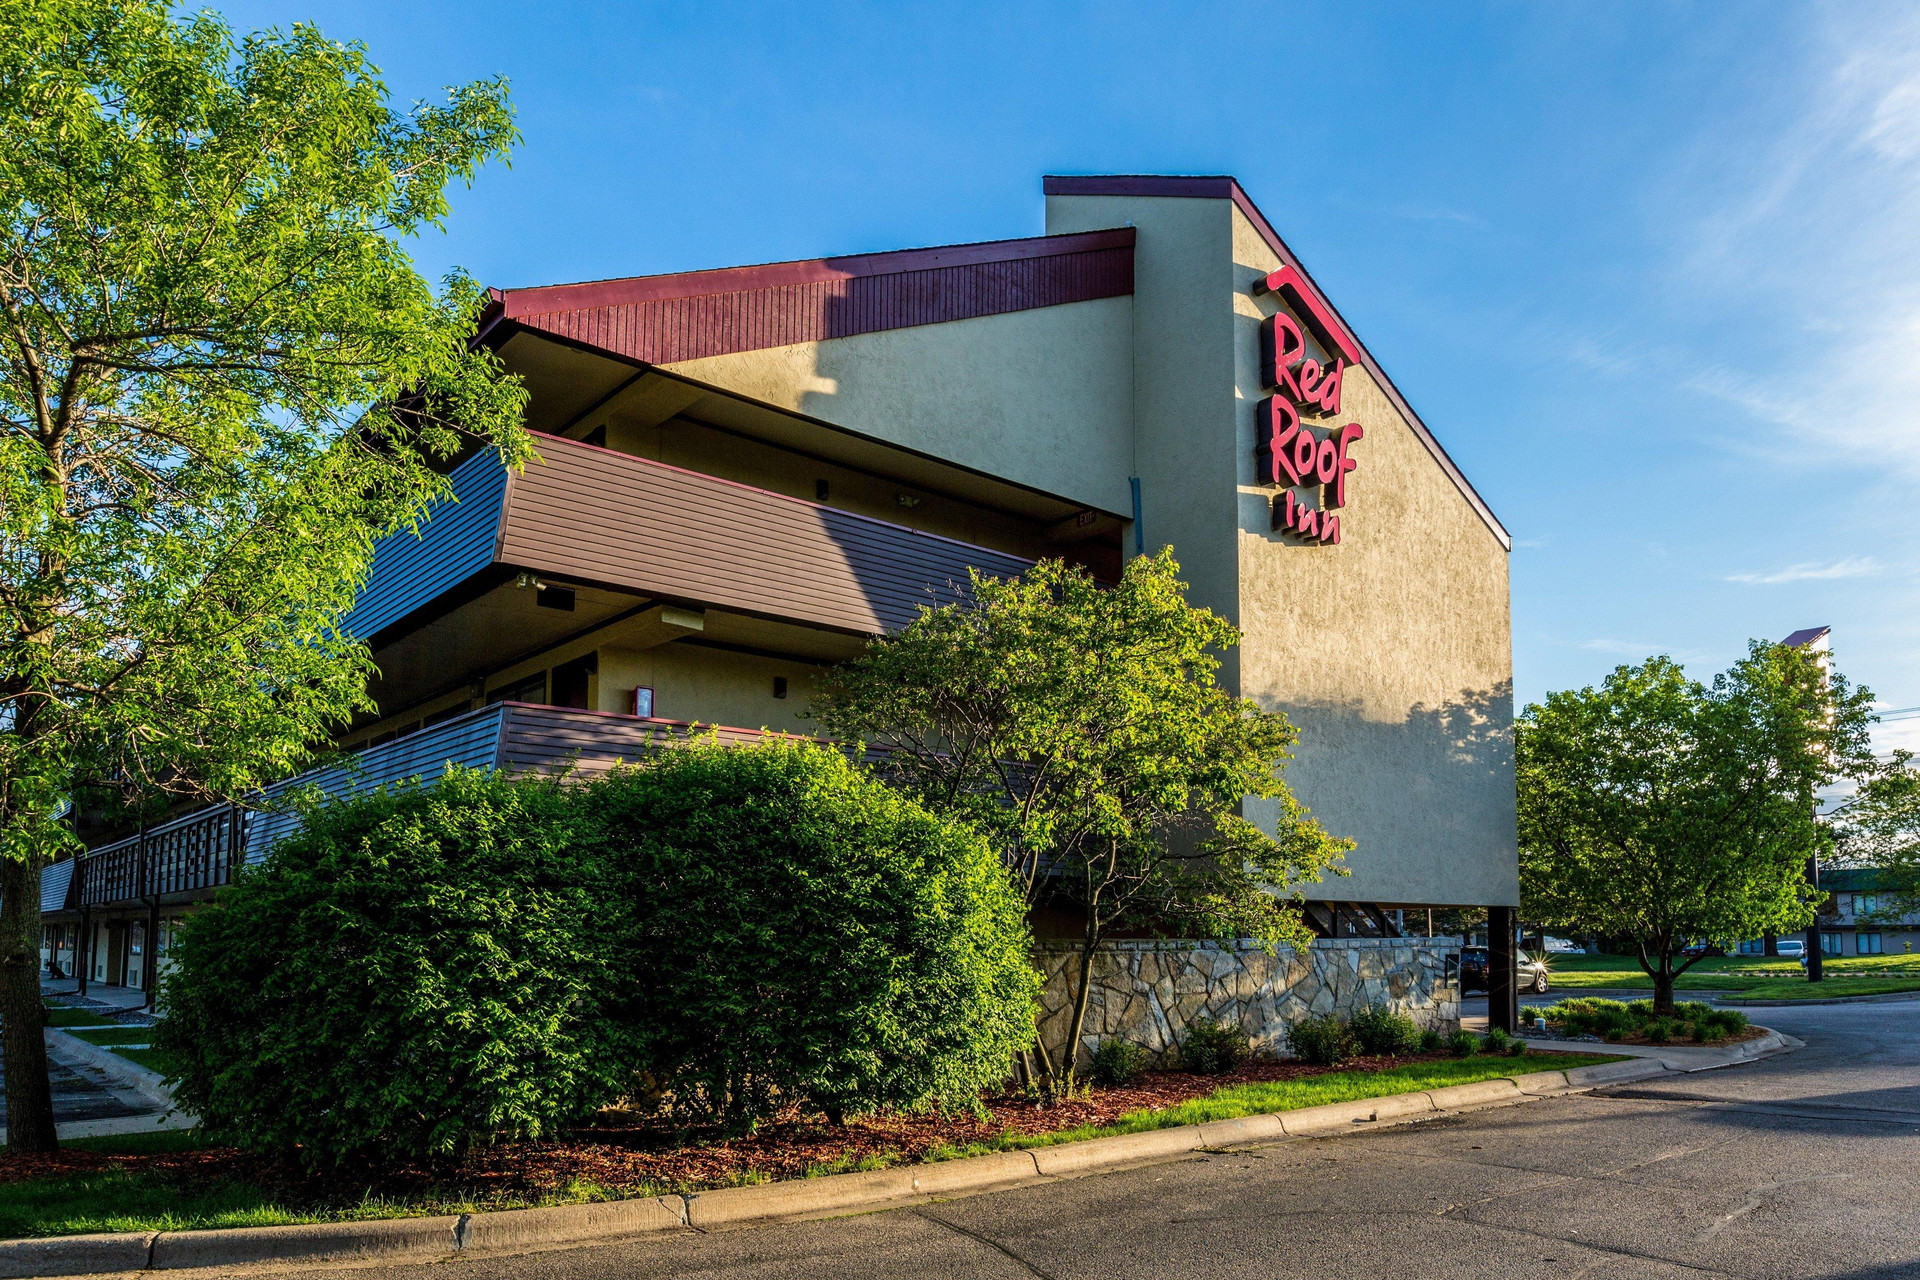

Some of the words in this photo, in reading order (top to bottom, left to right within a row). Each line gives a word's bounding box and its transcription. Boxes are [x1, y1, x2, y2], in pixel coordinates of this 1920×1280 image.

[1273, 312, 1344, 415] Red
[1271, 394, 1363, 508] Roof
[1079, 511, 1092, 526] EXIT
[1286, 490, 1340, 545] Inn
